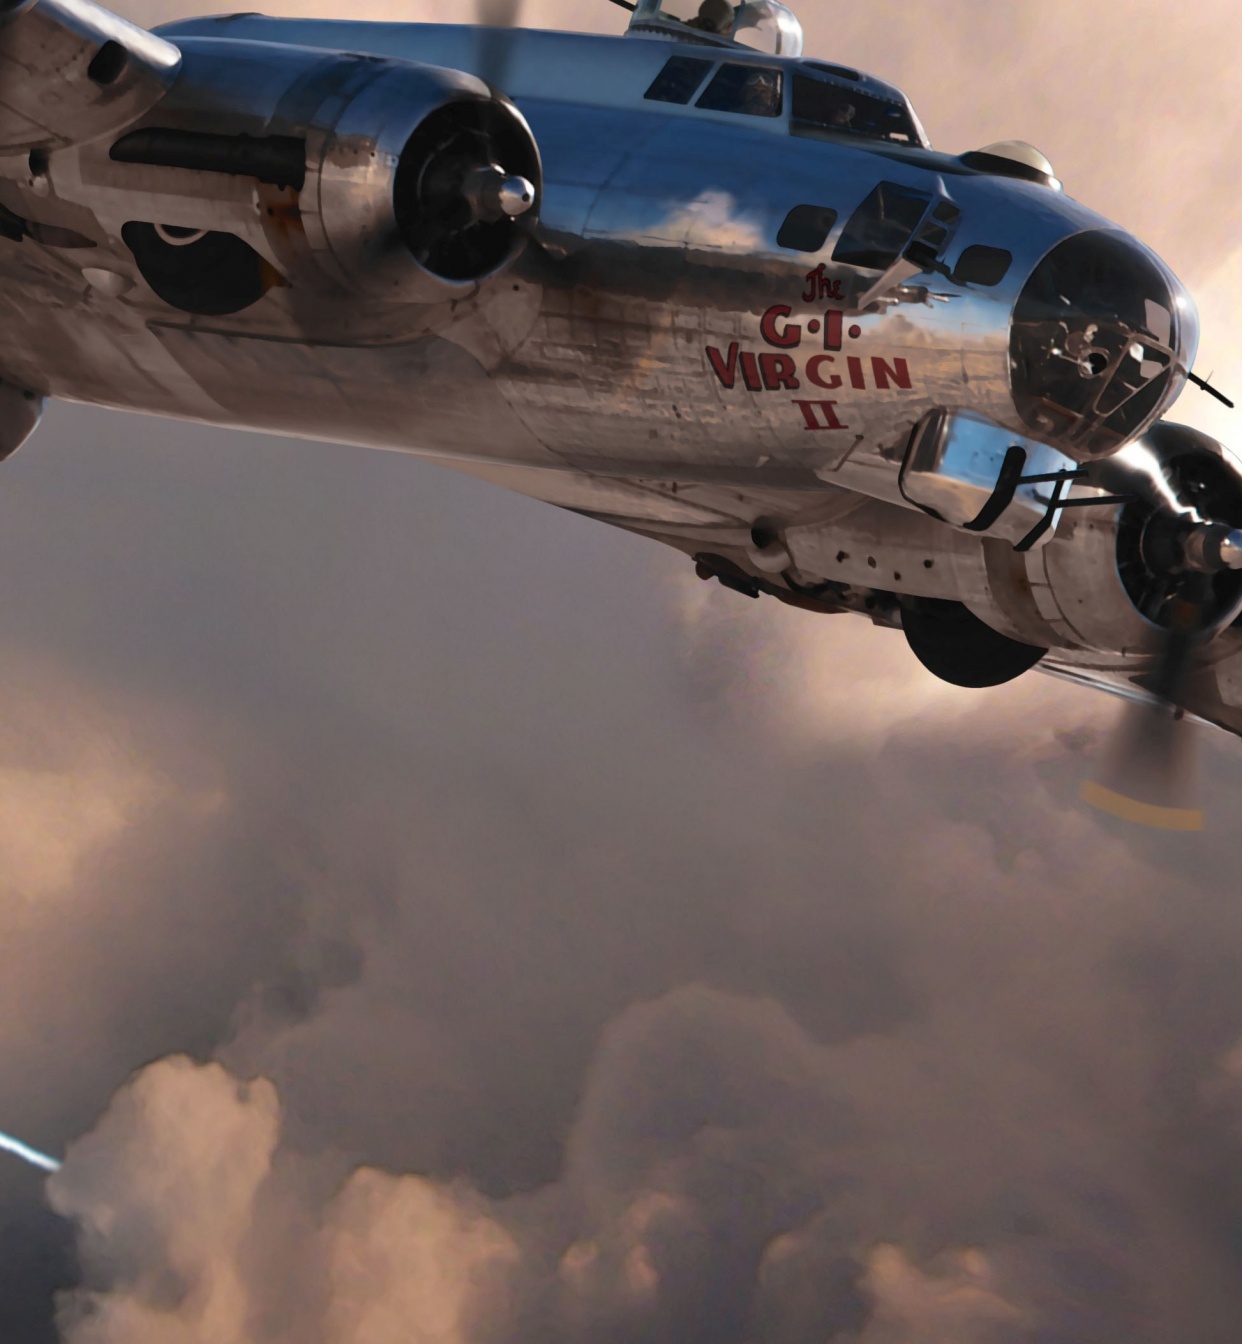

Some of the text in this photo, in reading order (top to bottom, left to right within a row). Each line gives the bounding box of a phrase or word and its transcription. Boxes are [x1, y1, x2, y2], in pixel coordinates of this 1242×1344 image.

[802, 263, 845, 302] The
[705, 342, 912, 392] VIRGIN
[791, 399, 849, 430] II
